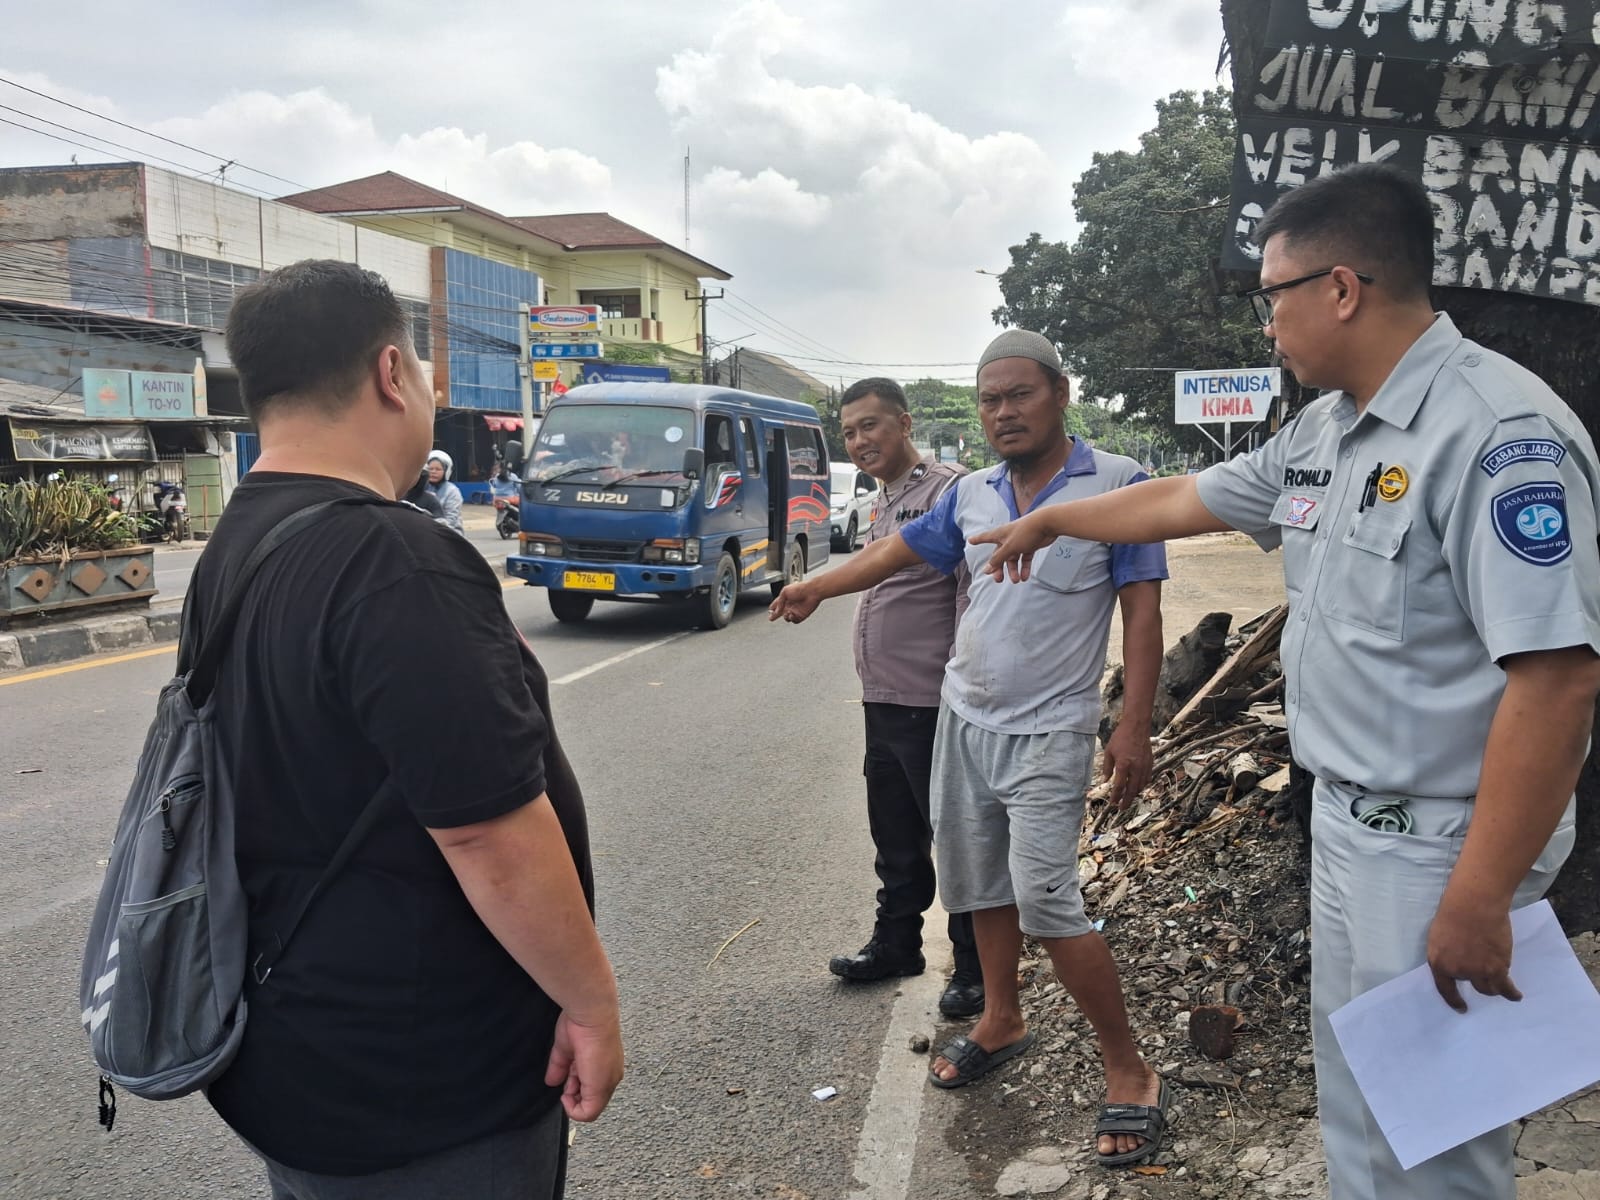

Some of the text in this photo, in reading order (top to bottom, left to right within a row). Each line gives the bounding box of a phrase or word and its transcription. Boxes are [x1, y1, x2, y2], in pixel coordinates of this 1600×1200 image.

[1254, 45, 1403, 119] JUAL
[542, 313, 586, 323] Indomaret
[142, 379, 185, 393] KANTIN
[1183, 375, 1272, 395] INTERNUSA
[148, 398, 182, 411] TO-YO
[1201, 396, 1254, 417] KIMIA
[1489, 444, 1559, 468] CABANG JABAR
[1283, 467, 1332, 487] RONALD
[576, 491, 629, 505] ISUZU
[1502, 496, 1524, 511] JASA
